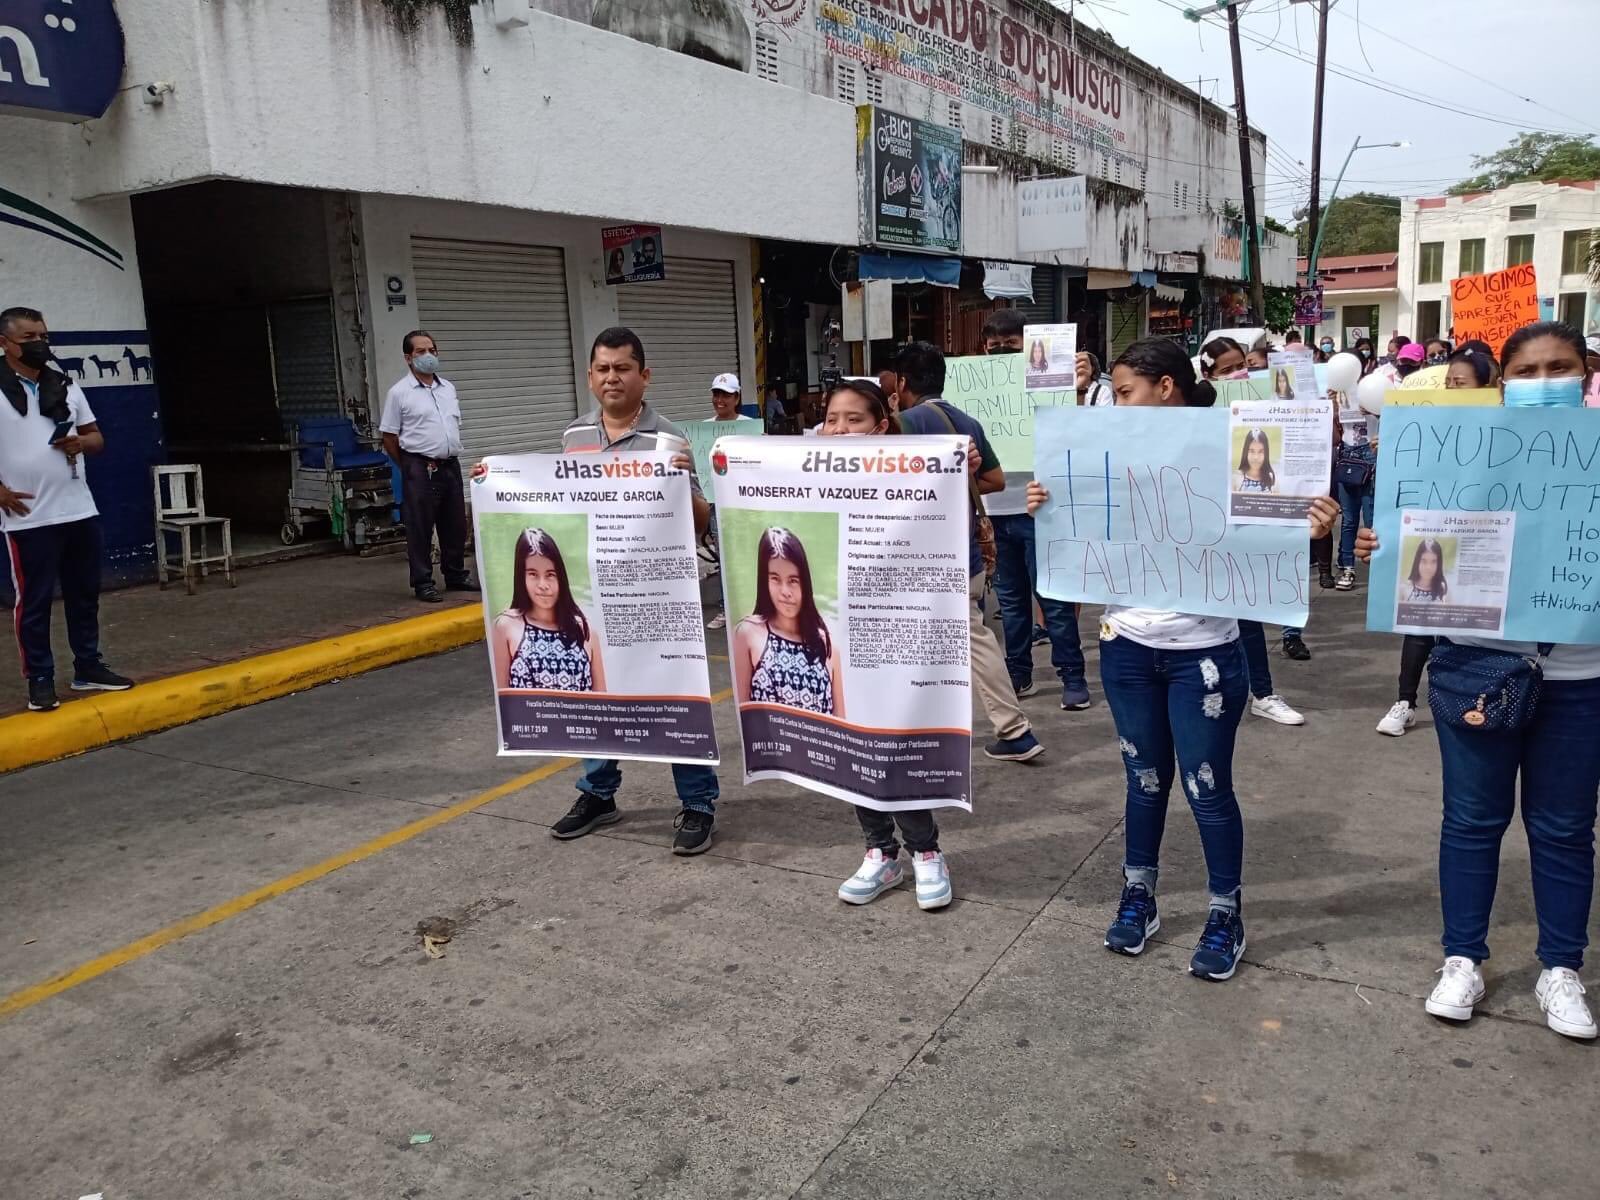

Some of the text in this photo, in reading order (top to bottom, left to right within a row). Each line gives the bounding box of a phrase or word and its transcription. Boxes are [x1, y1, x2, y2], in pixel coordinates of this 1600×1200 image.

[825, 35, 868, 64] TALLERES
[870, 7, 930, 45] PRODUCTOS
[933, 34, 969, 62] FRESCOS
[971, 51, 982, 66] DE
[983, 57, 1017, 83] CALIDAD
[1000, 20, 1122, 120] SOCONUSCO
[889, 115, 912, 141] BICI
[1454, 265, 1536, 301] EXIGIMOS
[1485, 290, 1512, 303] QUE
[1453, 294, 1538, 321] APAREZCA LA
[1482, 311, 1518, 327] JOVEN
[945, 355, 1017, 393] MONTSE
[964, 393, 1037, 419] FAMILIA
[496, 491, 665, 503] MONSERRAT VAZQUEZ GARCIA
[738, 486, 937, 501] MONSERRAT VAZQUEZ GARCIA
[1050, 449, 1227, 547] #NOS
[1047, 539, 1310, 607] FALTA MONTSE
[1552, 566, 1593, 591] Hoy
